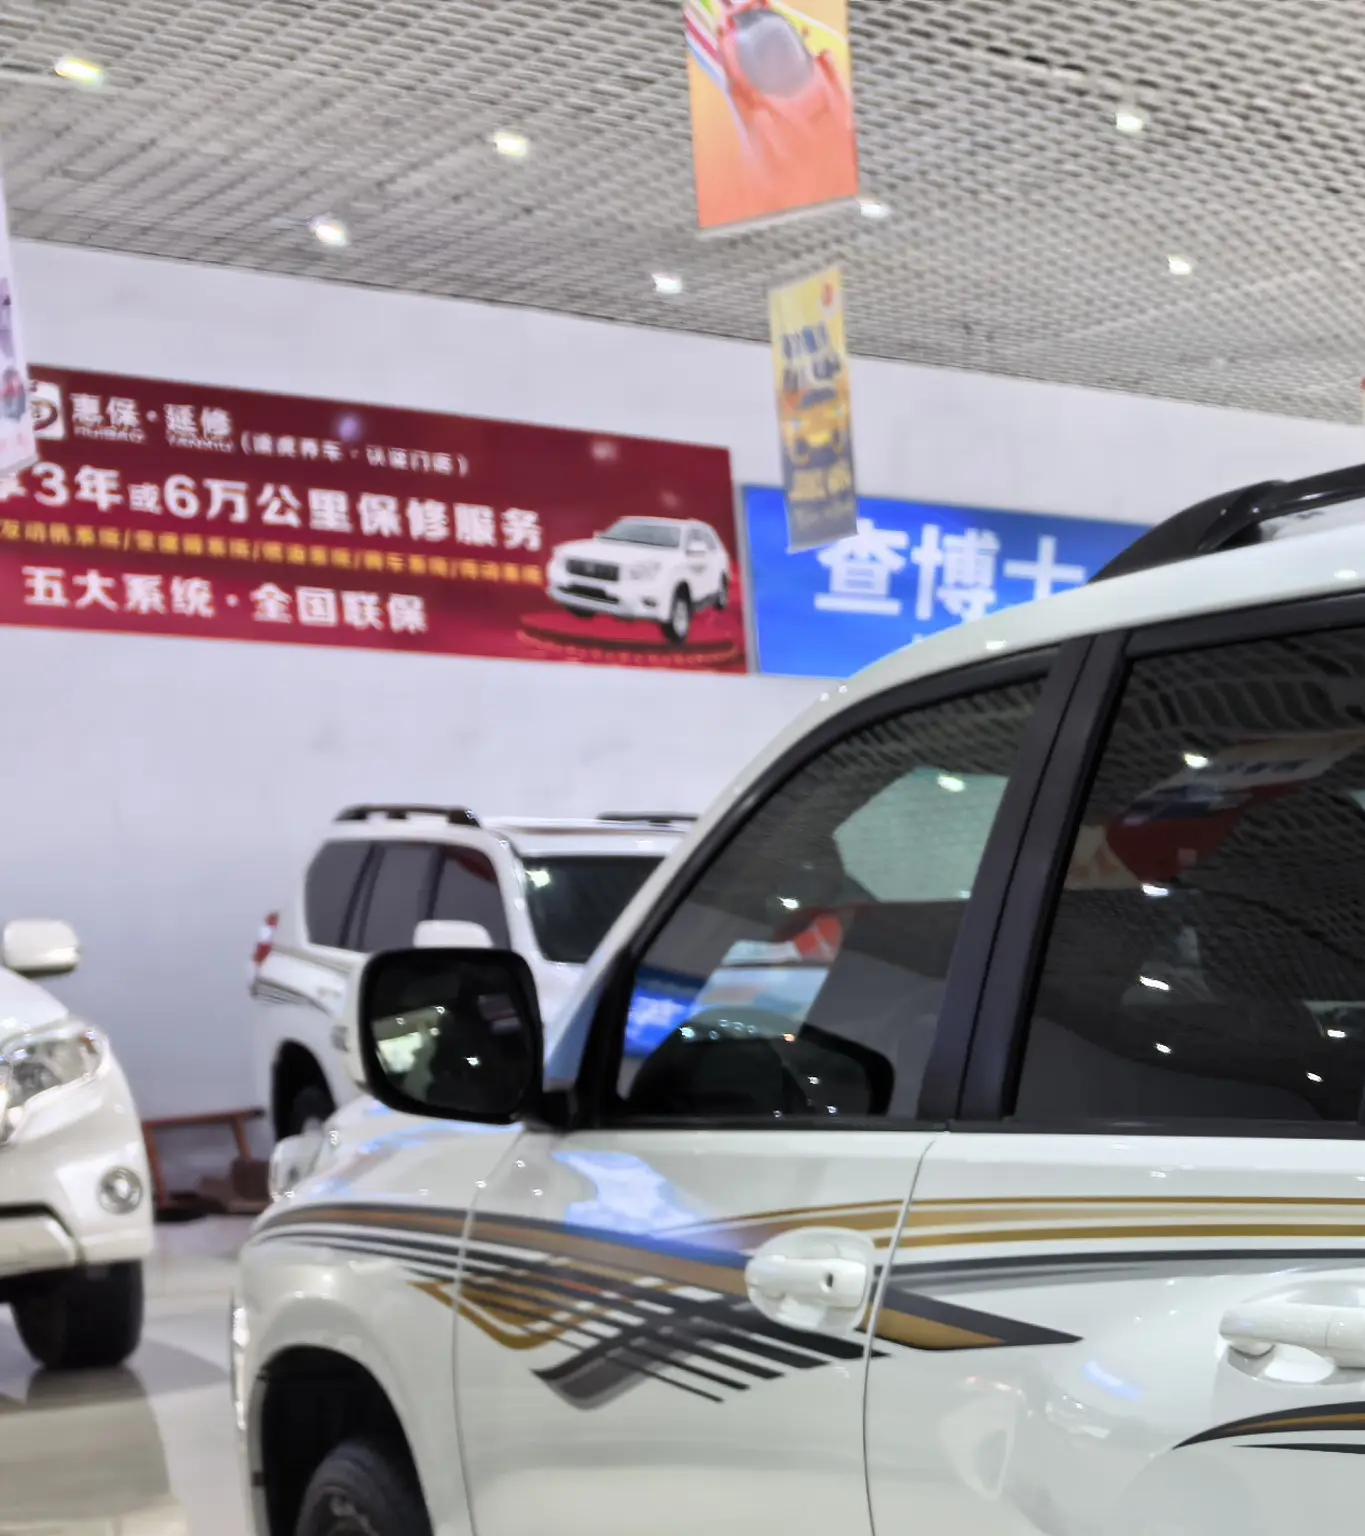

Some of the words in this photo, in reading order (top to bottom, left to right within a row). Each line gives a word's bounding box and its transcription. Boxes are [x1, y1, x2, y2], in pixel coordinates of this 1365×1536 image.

[22, 565, 428, 634] 五大系统·全国联保
